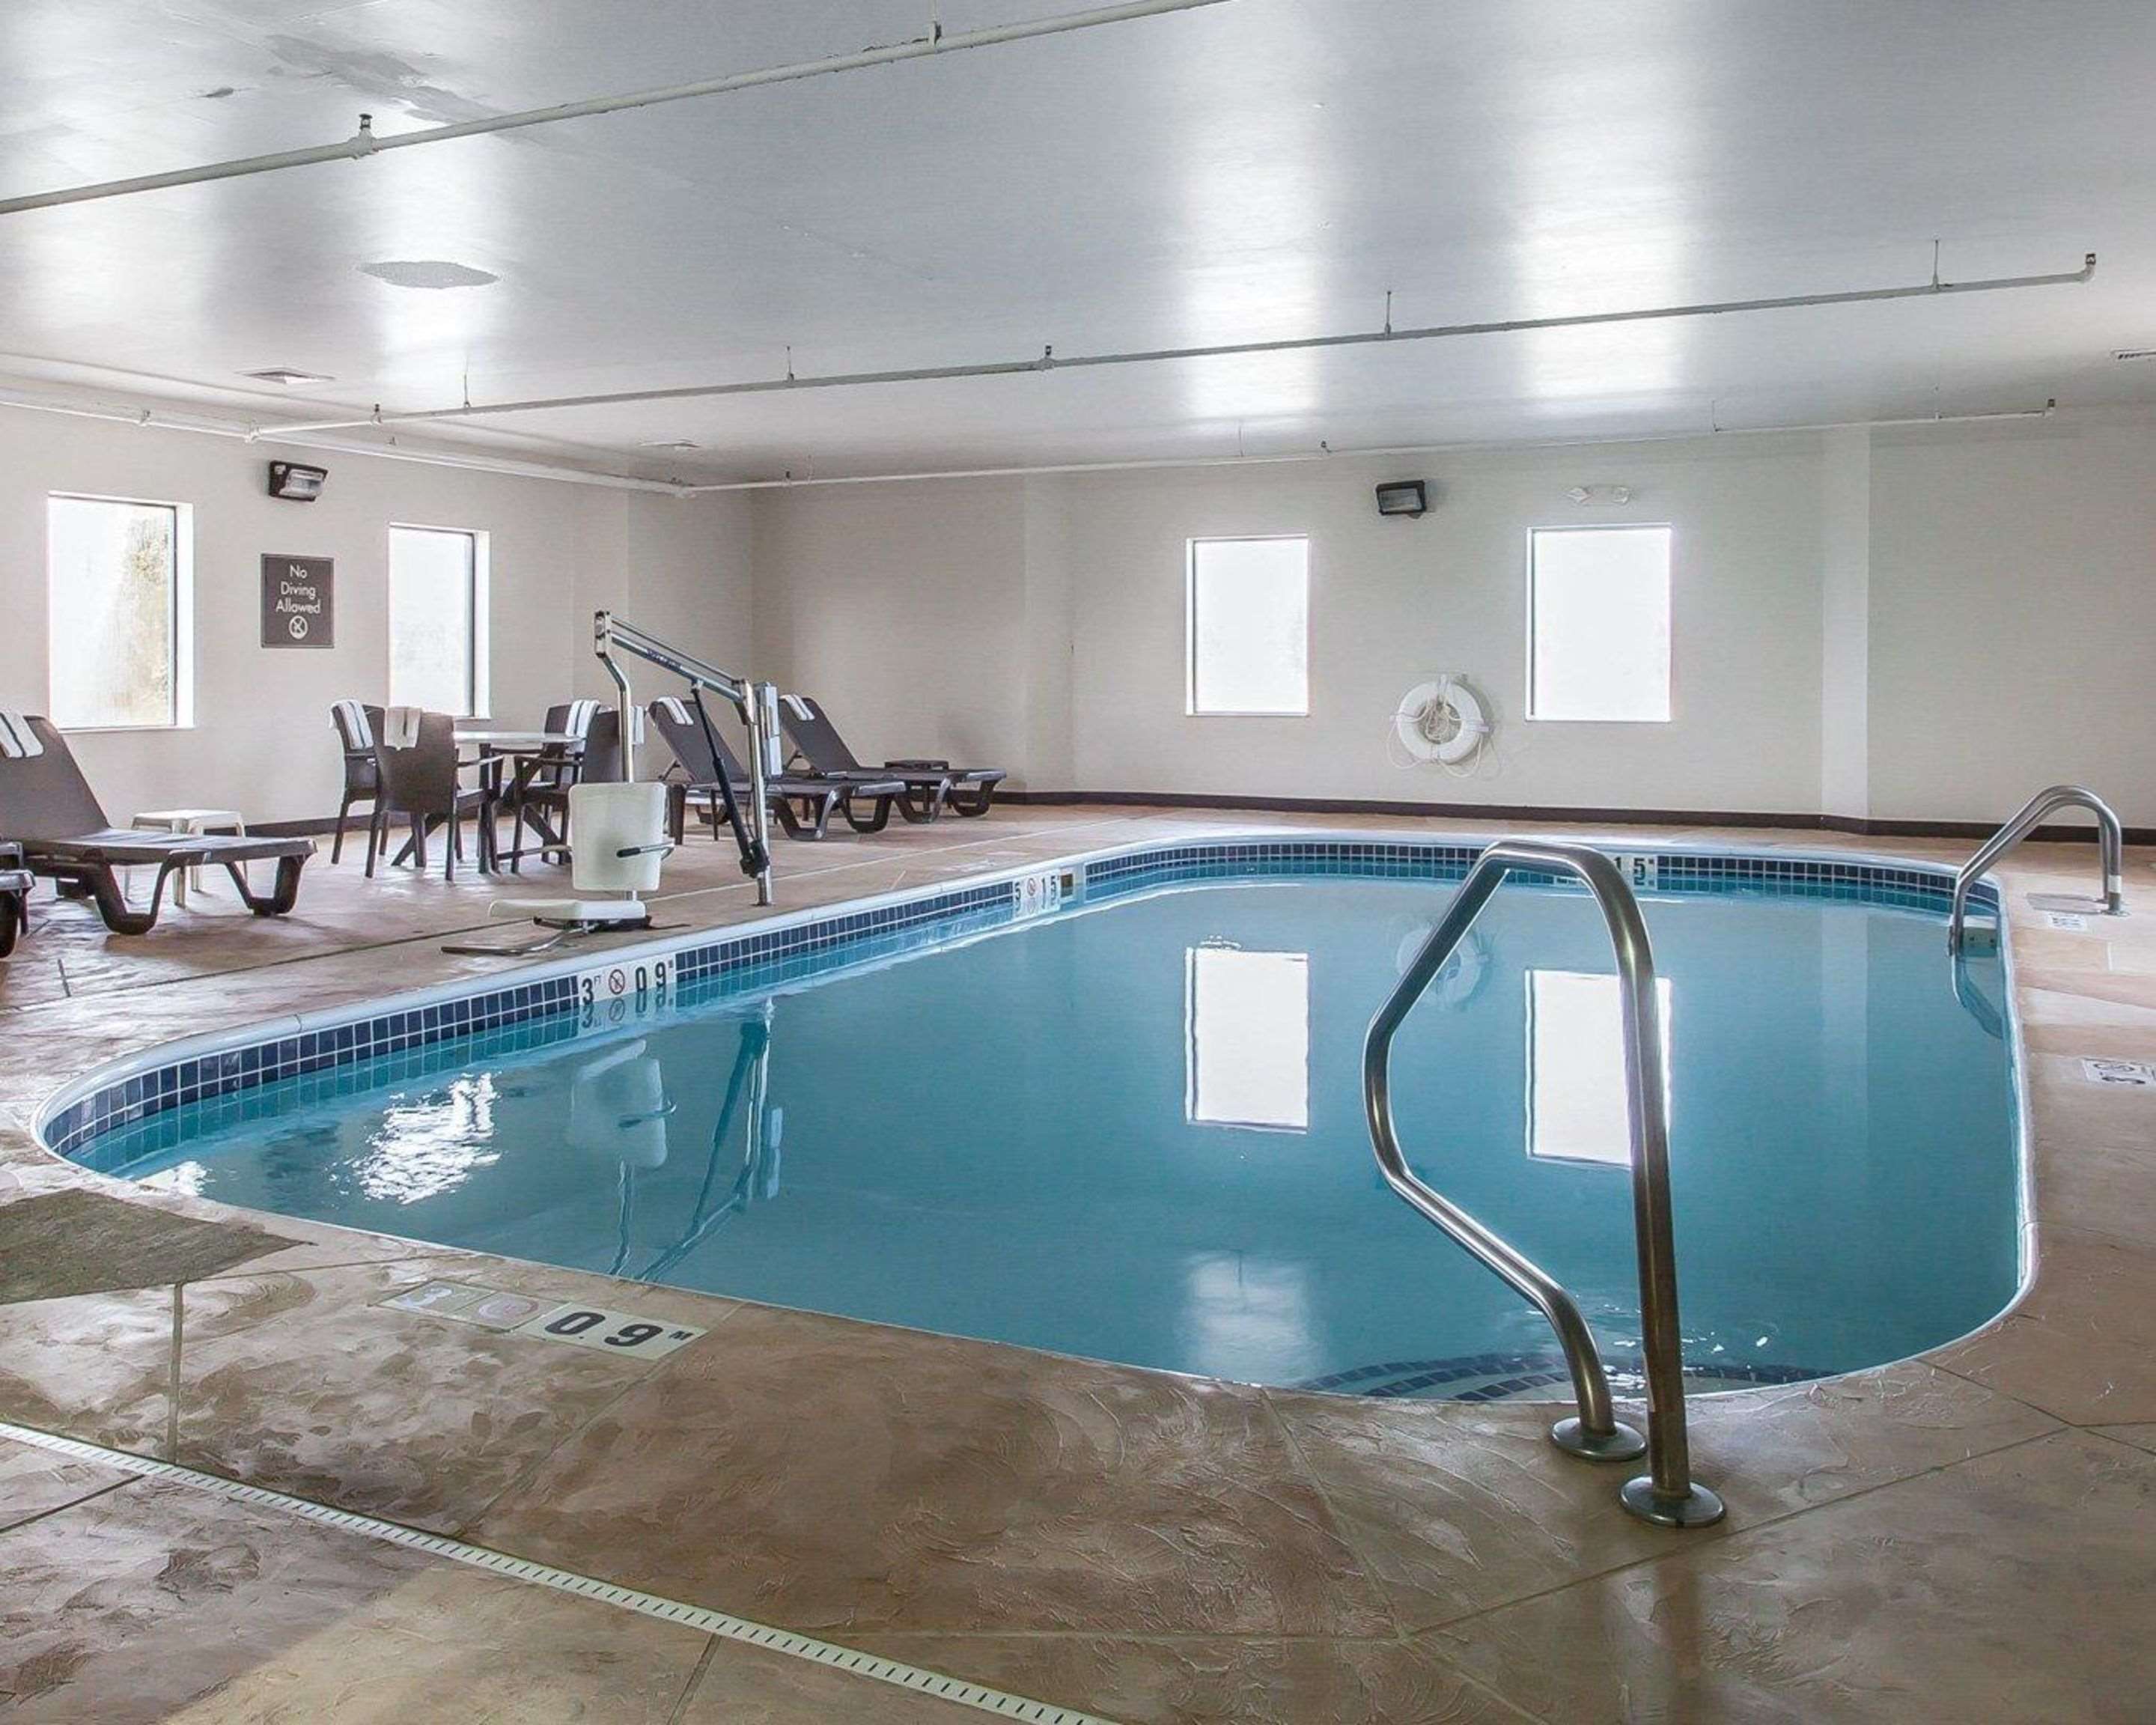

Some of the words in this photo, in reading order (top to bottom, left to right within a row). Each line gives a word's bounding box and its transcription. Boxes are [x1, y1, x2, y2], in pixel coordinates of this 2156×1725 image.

[290, 564, 308, 579] No
[281, 580, 316, 600] Diving
[275, 597, 321, 614] Allowed
[582, 977, 594, 1005] 3
